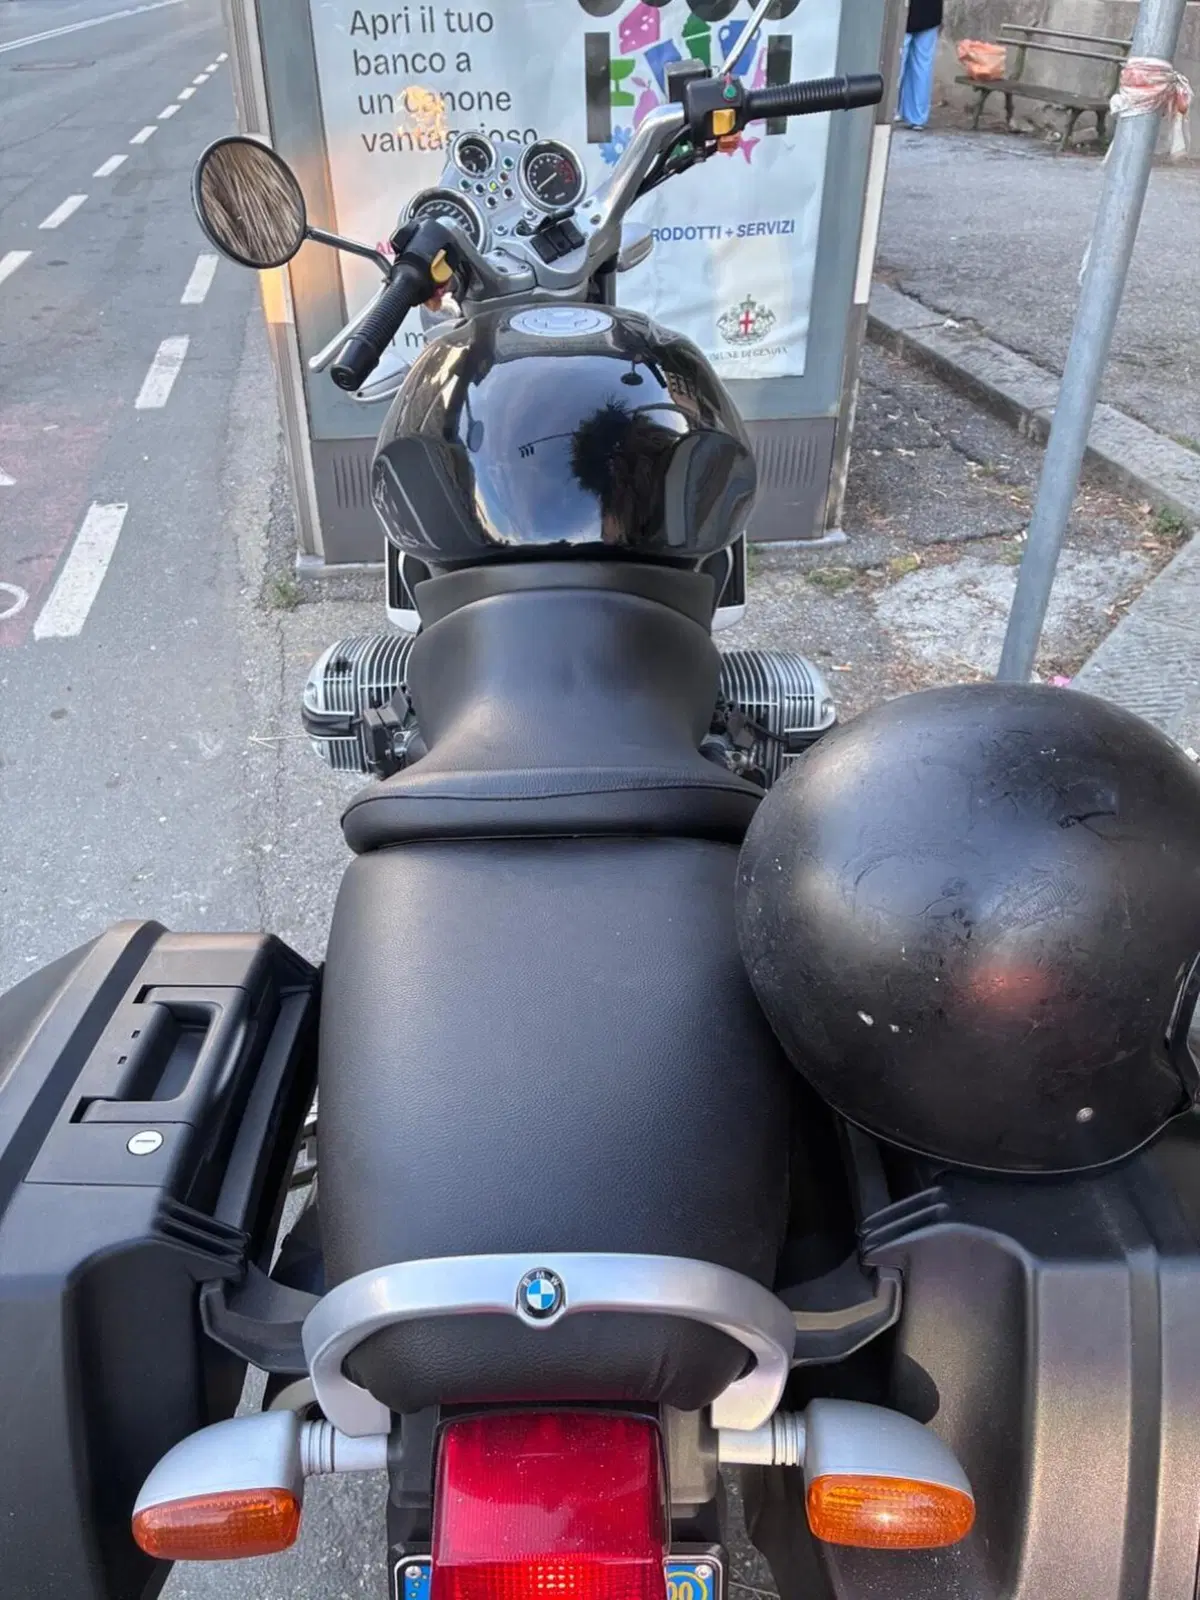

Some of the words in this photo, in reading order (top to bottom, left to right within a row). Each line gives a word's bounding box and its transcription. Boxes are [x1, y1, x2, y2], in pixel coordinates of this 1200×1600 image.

[350, 6, 410, 41] Apri
[420, 6, 435, 33] il
[444, 8, 494, 33] tuo
[353, 48, 446, 76] banco
[455, 51, 472, 73] a
[358, 93, 394, 115] un
[404, 90, 512, 113] canone
[650, 226, 721, 241] RODOTTI
[736, 220, 795, 238] SERVIZI
[521, 1270, 561, 1288] BMW
